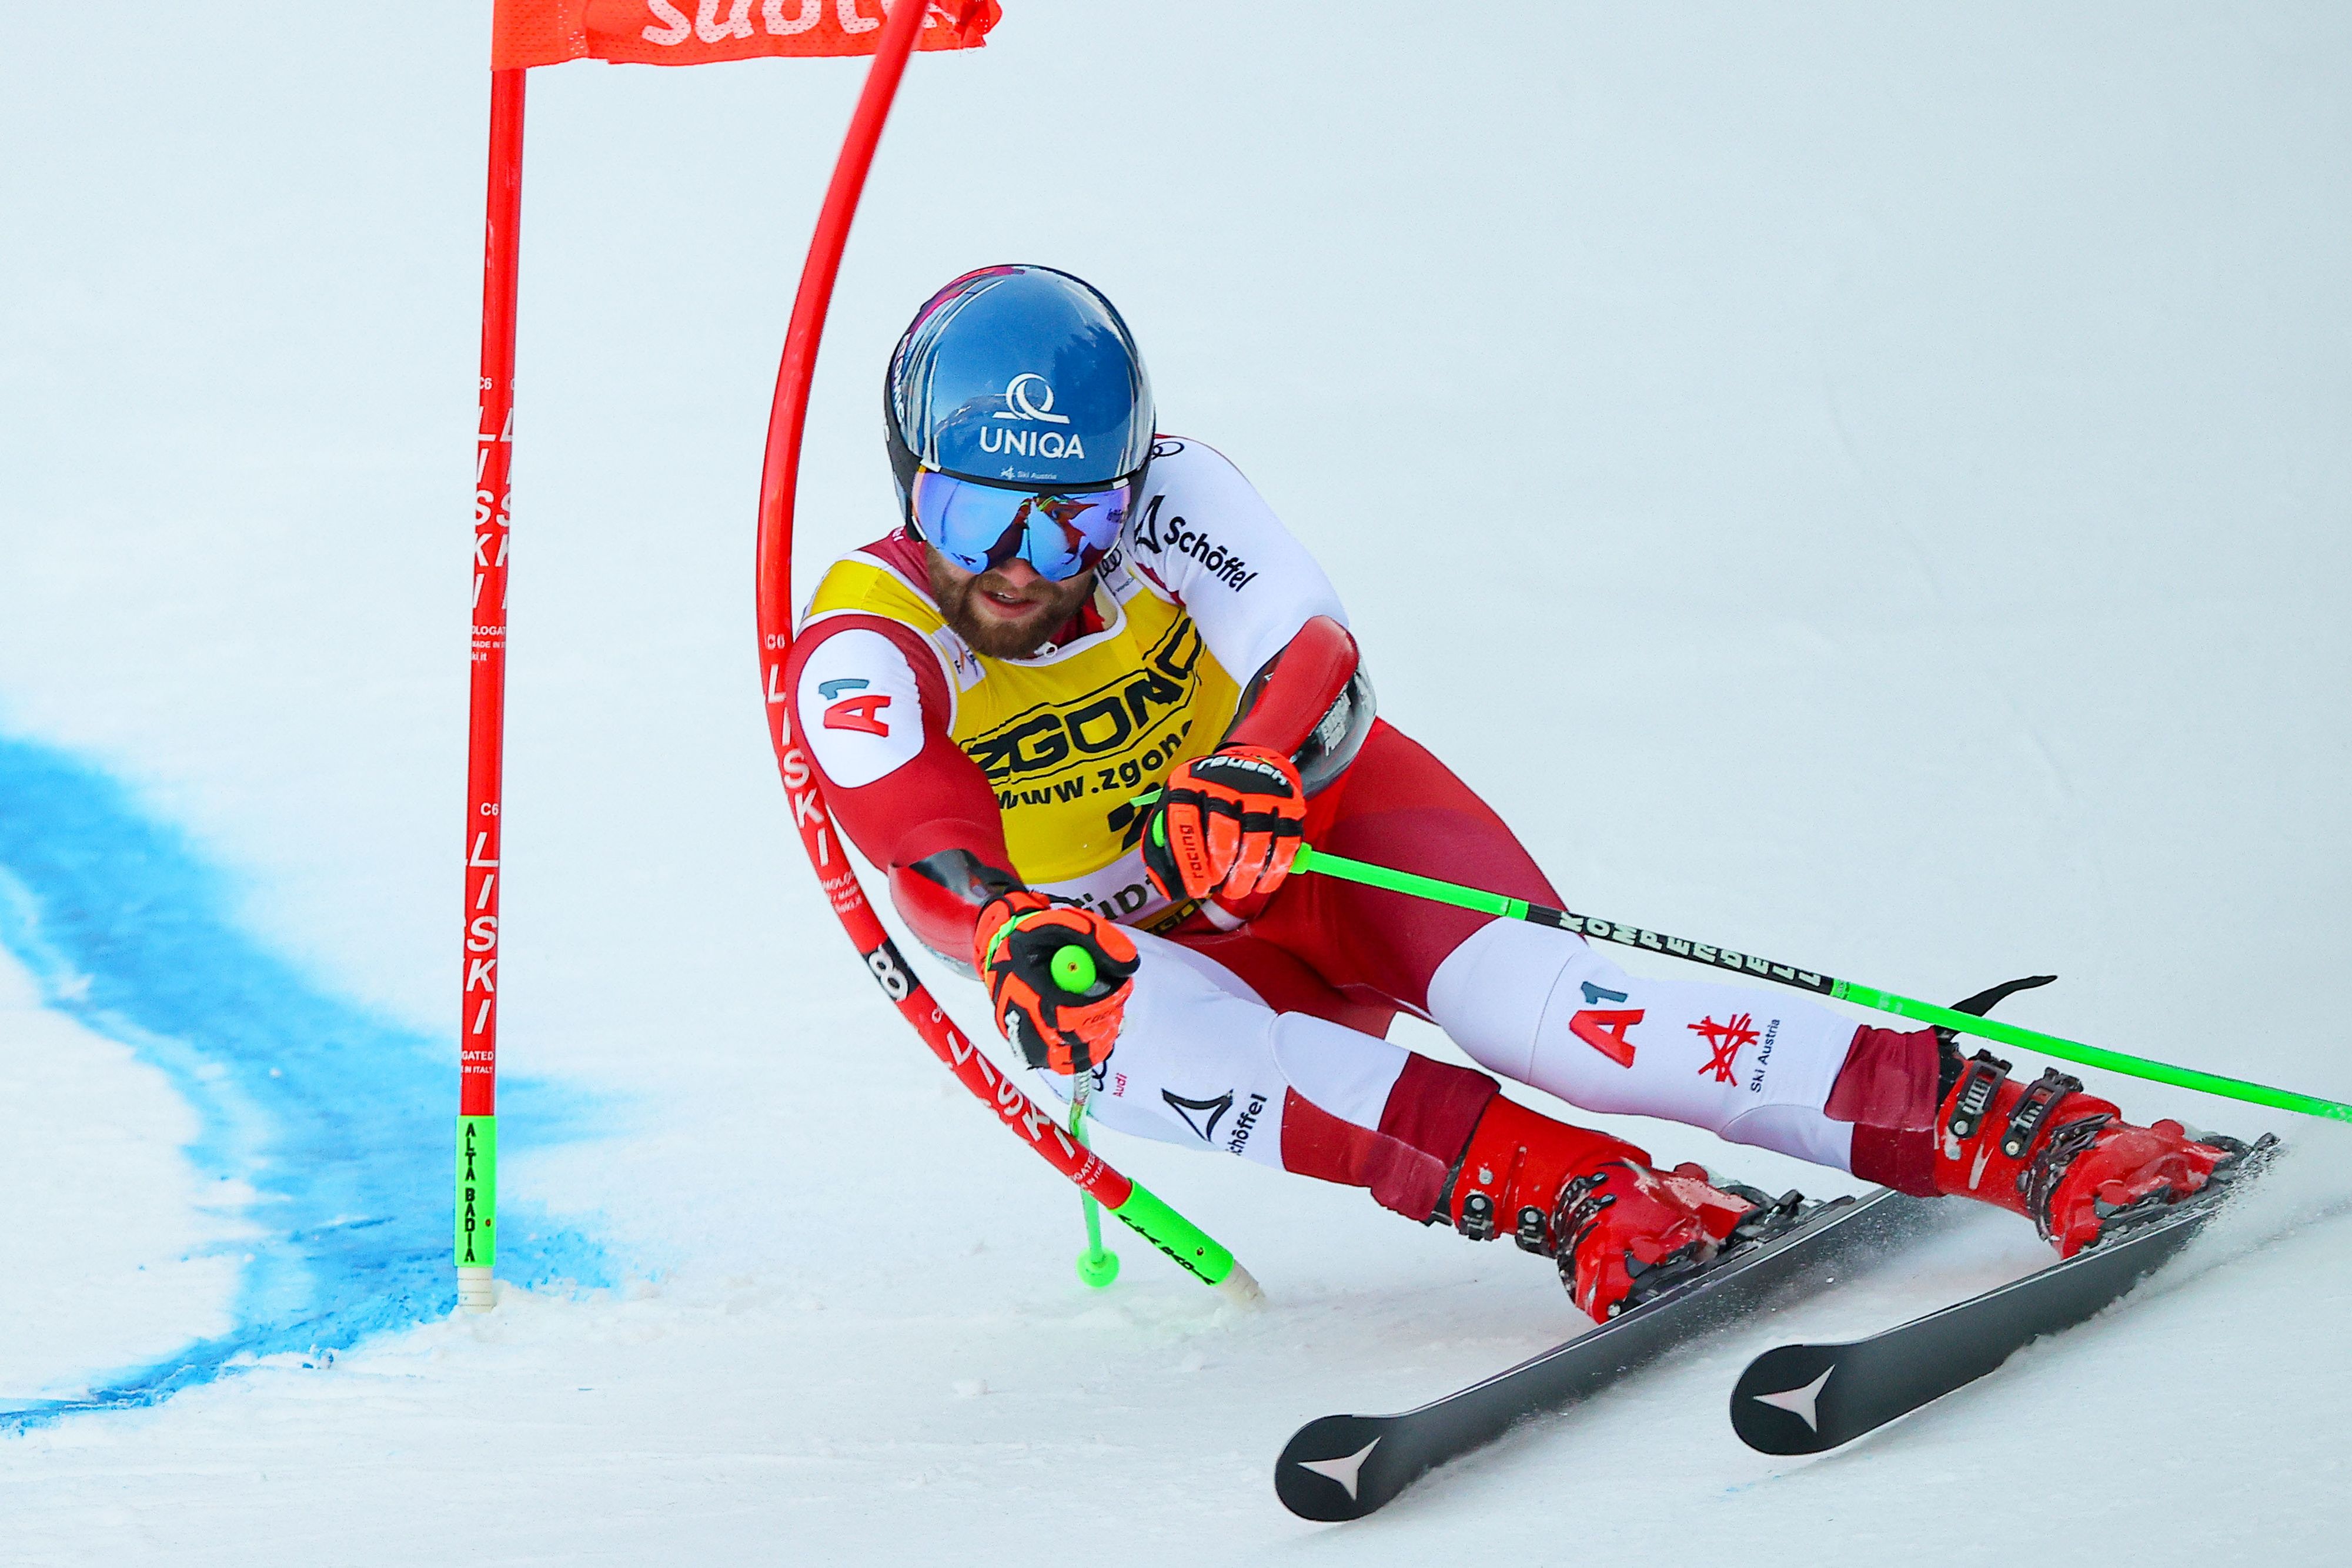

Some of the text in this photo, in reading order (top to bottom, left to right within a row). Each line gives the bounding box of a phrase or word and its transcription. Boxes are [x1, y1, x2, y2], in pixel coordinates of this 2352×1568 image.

[979, 426, 1085, 459] UNIQA
[767, 664, 829, 867] LISKI
[480, 803, 499, 816] C6
[1180, 824, 1204, 878] racing
[466, 832, 499, 1035] LISKI
[1558, 911, 1822, 988] KOMPERDELL
[868, 944, 908, 1002] 8
[1569, 981, 1645, 1069] A1
[1750, 1019, 1780, 1093] Ski Austria
[946, 1030, 1076, 1161] LISKI
[1112, 1073, 1127, 1098] Audi
[464, 1124, 476, 1262] ALTA BADIA
